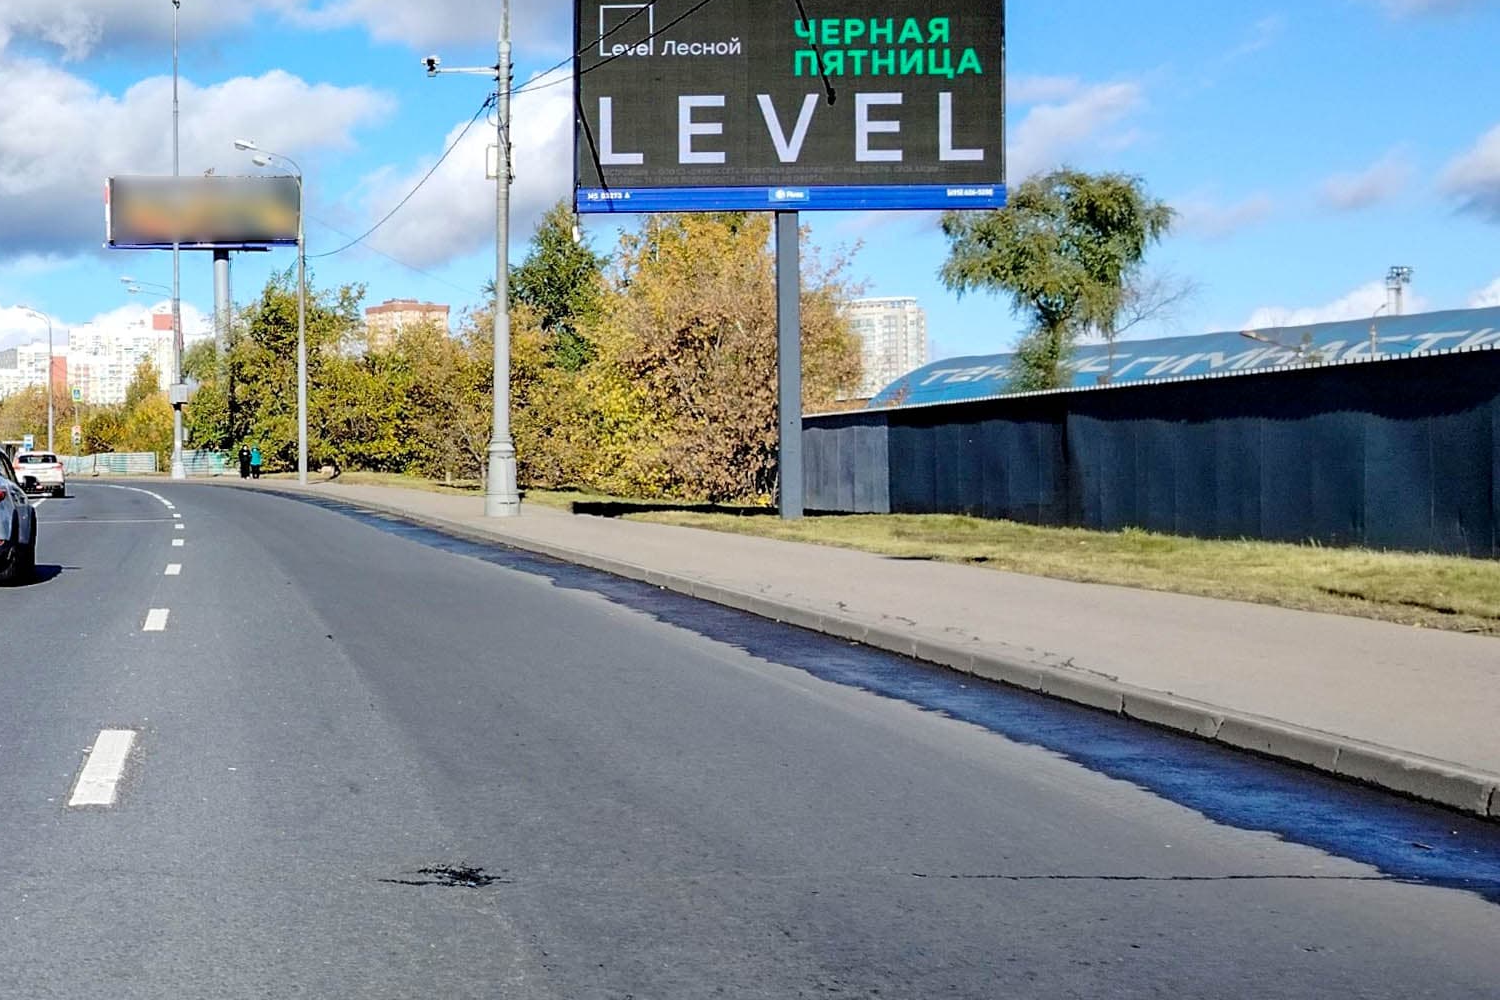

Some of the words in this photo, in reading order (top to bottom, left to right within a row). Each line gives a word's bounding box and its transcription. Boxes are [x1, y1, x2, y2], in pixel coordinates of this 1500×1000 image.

[794, 17, 949, 45] ЧЕРНАЯ
[599, 36, 653, 57] Level
[661, 37, 741, 56] Лесной
[794, 48, 983, 80] ПЯТНИЦА
[599, 92, 984, 165] LEVEL
